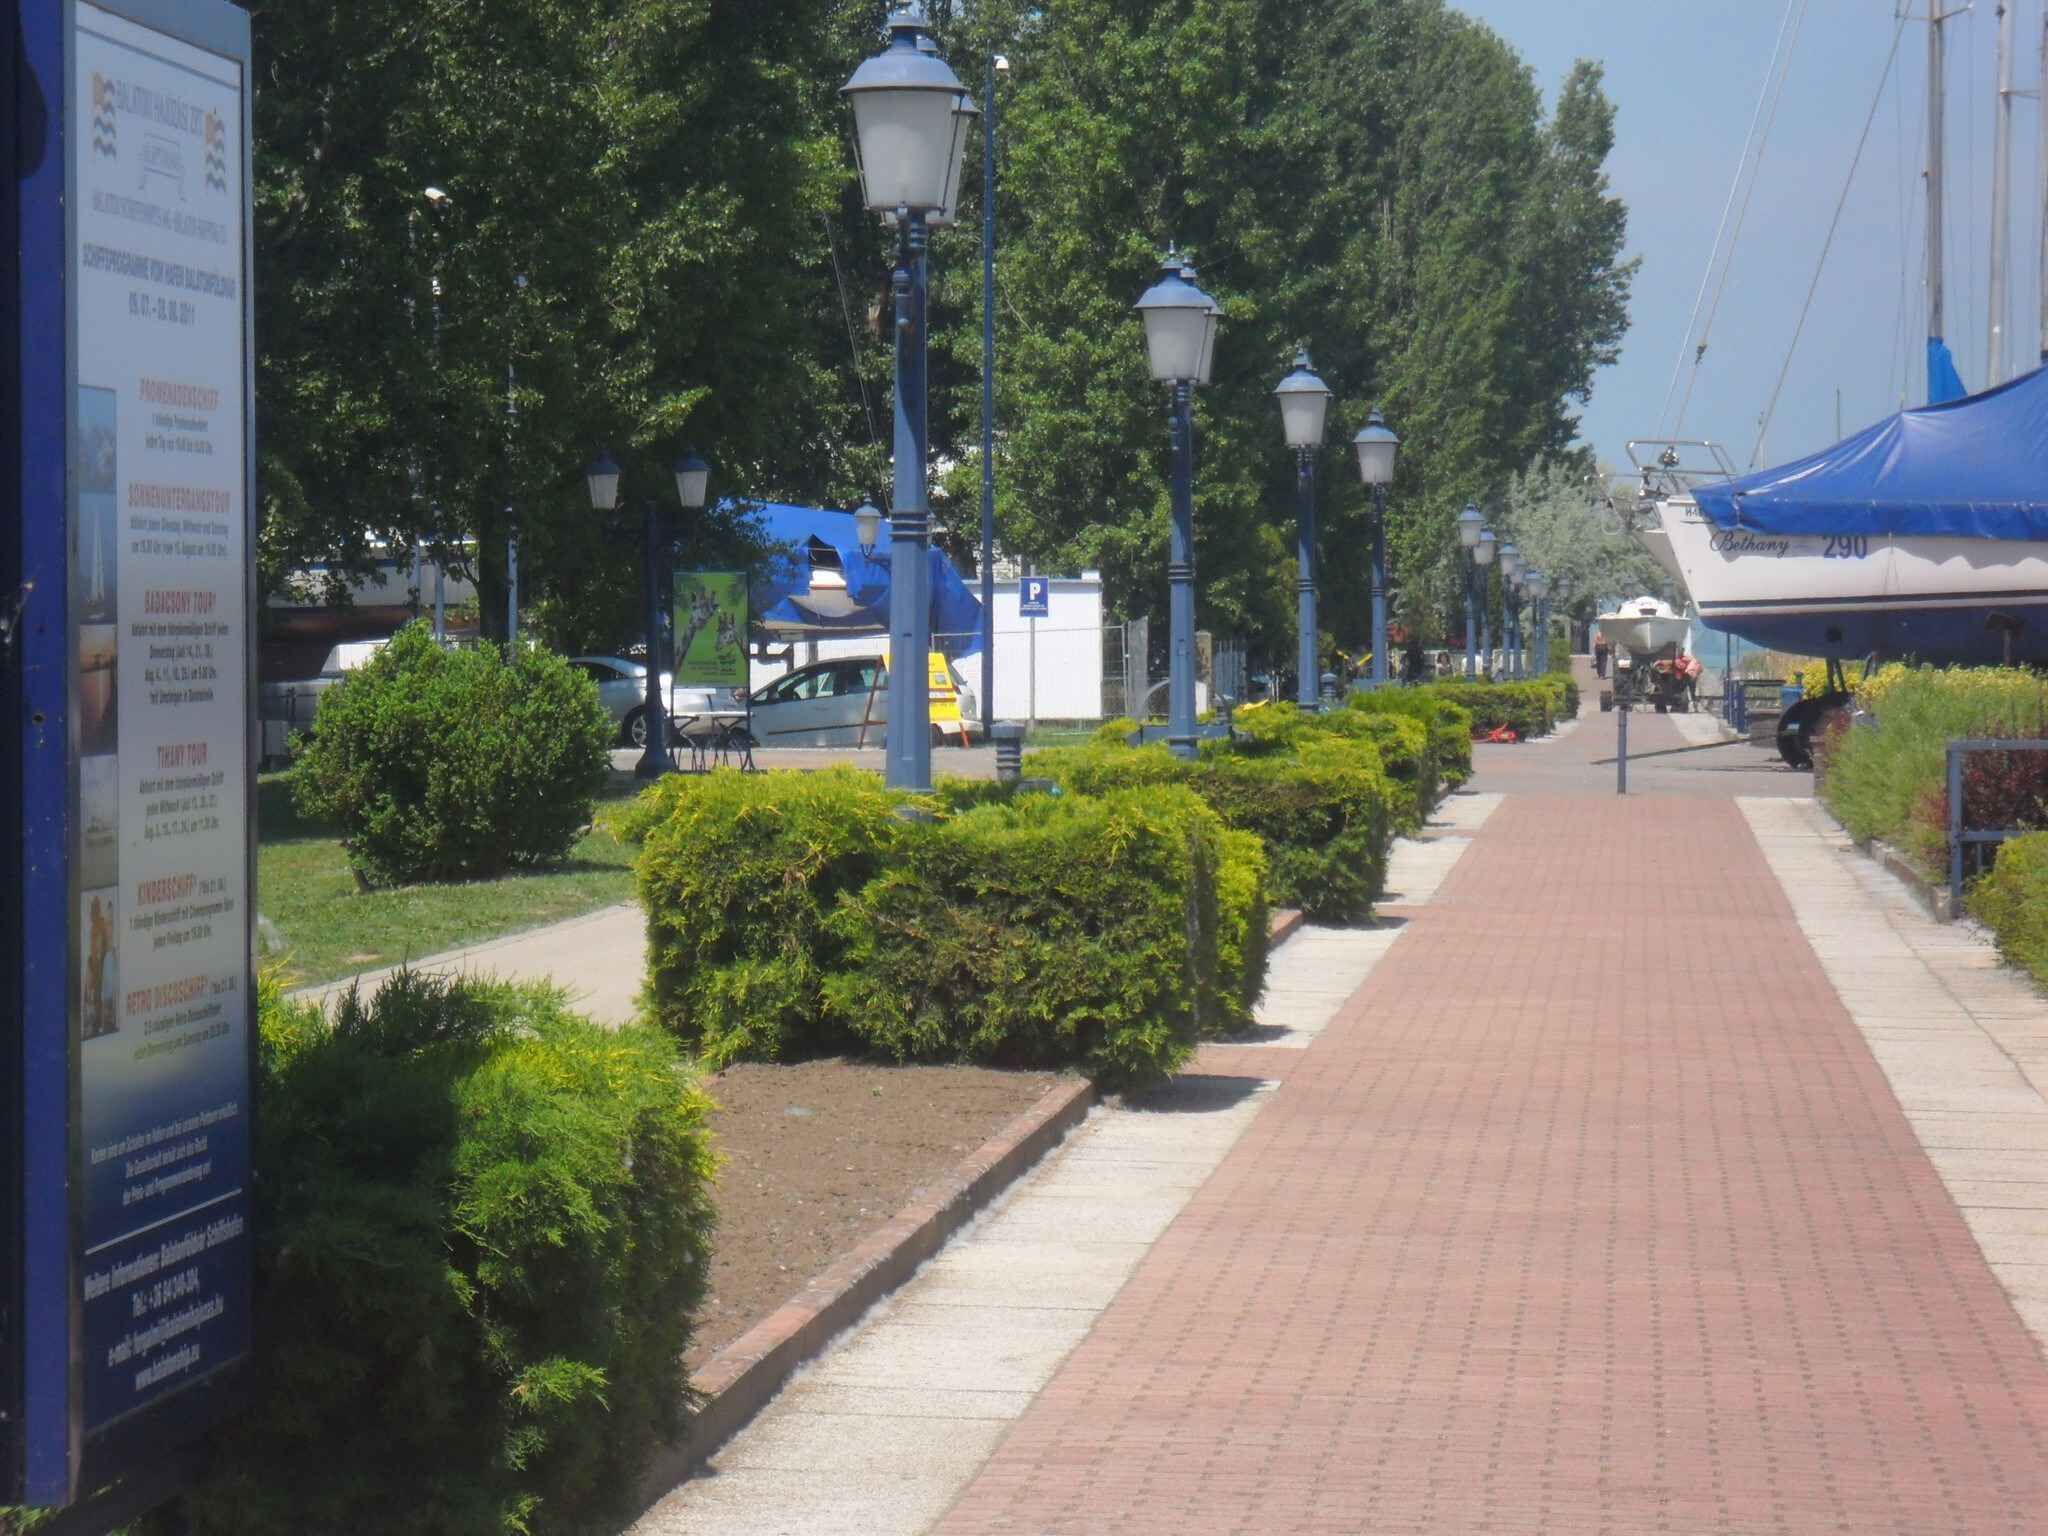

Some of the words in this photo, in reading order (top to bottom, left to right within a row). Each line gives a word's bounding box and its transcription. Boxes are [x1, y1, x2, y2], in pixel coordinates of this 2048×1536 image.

[1710, 531, 1788, 558] Bethany
[1823, 535, 1868, 559] 290
[145, 592, 191, 614] BADACSONY
[1030, 583, 1040, 600] P
[158, 745, 184, 769] TIHANY
